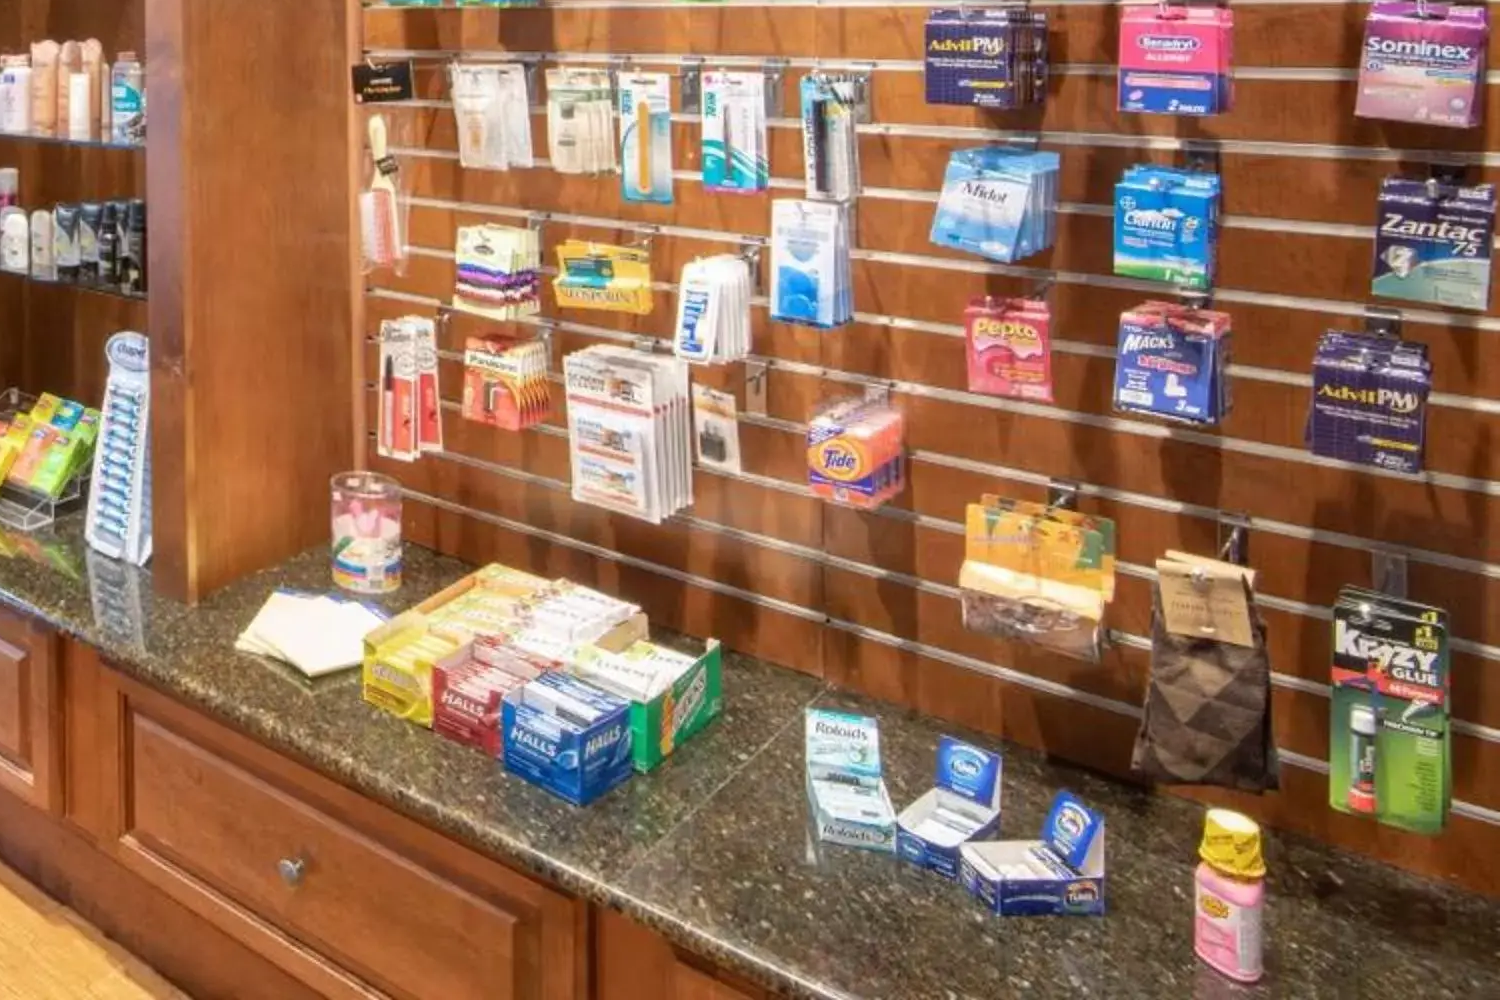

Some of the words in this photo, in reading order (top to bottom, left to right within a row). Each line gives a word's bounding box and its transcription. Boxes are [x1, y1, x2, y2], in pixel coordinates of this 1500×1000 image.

[1143, 37, 1193, 49] Benadryl
[1367, 36, 1472, 60] Sominex
[963, 181, 1008, 204] Midol
[1381, 213, 1487, 243] Zantac
[1451, 241, 1481, 257] 75
[978, 319, 1038, 340] Pepto
[823, 449, 857, 469] Tide
[1335, 619, 1439, 672] KRAZY
[1392, 667, 1438, 687] GLUE
[441, 689, 486, 717] HALLS
[510, 726, 557, 757] HALLS
[584, 724, 622, 758] HALLS
[815, 721, 868, 742] Rolaids
[823, 824, 873, 842] Rolaids
